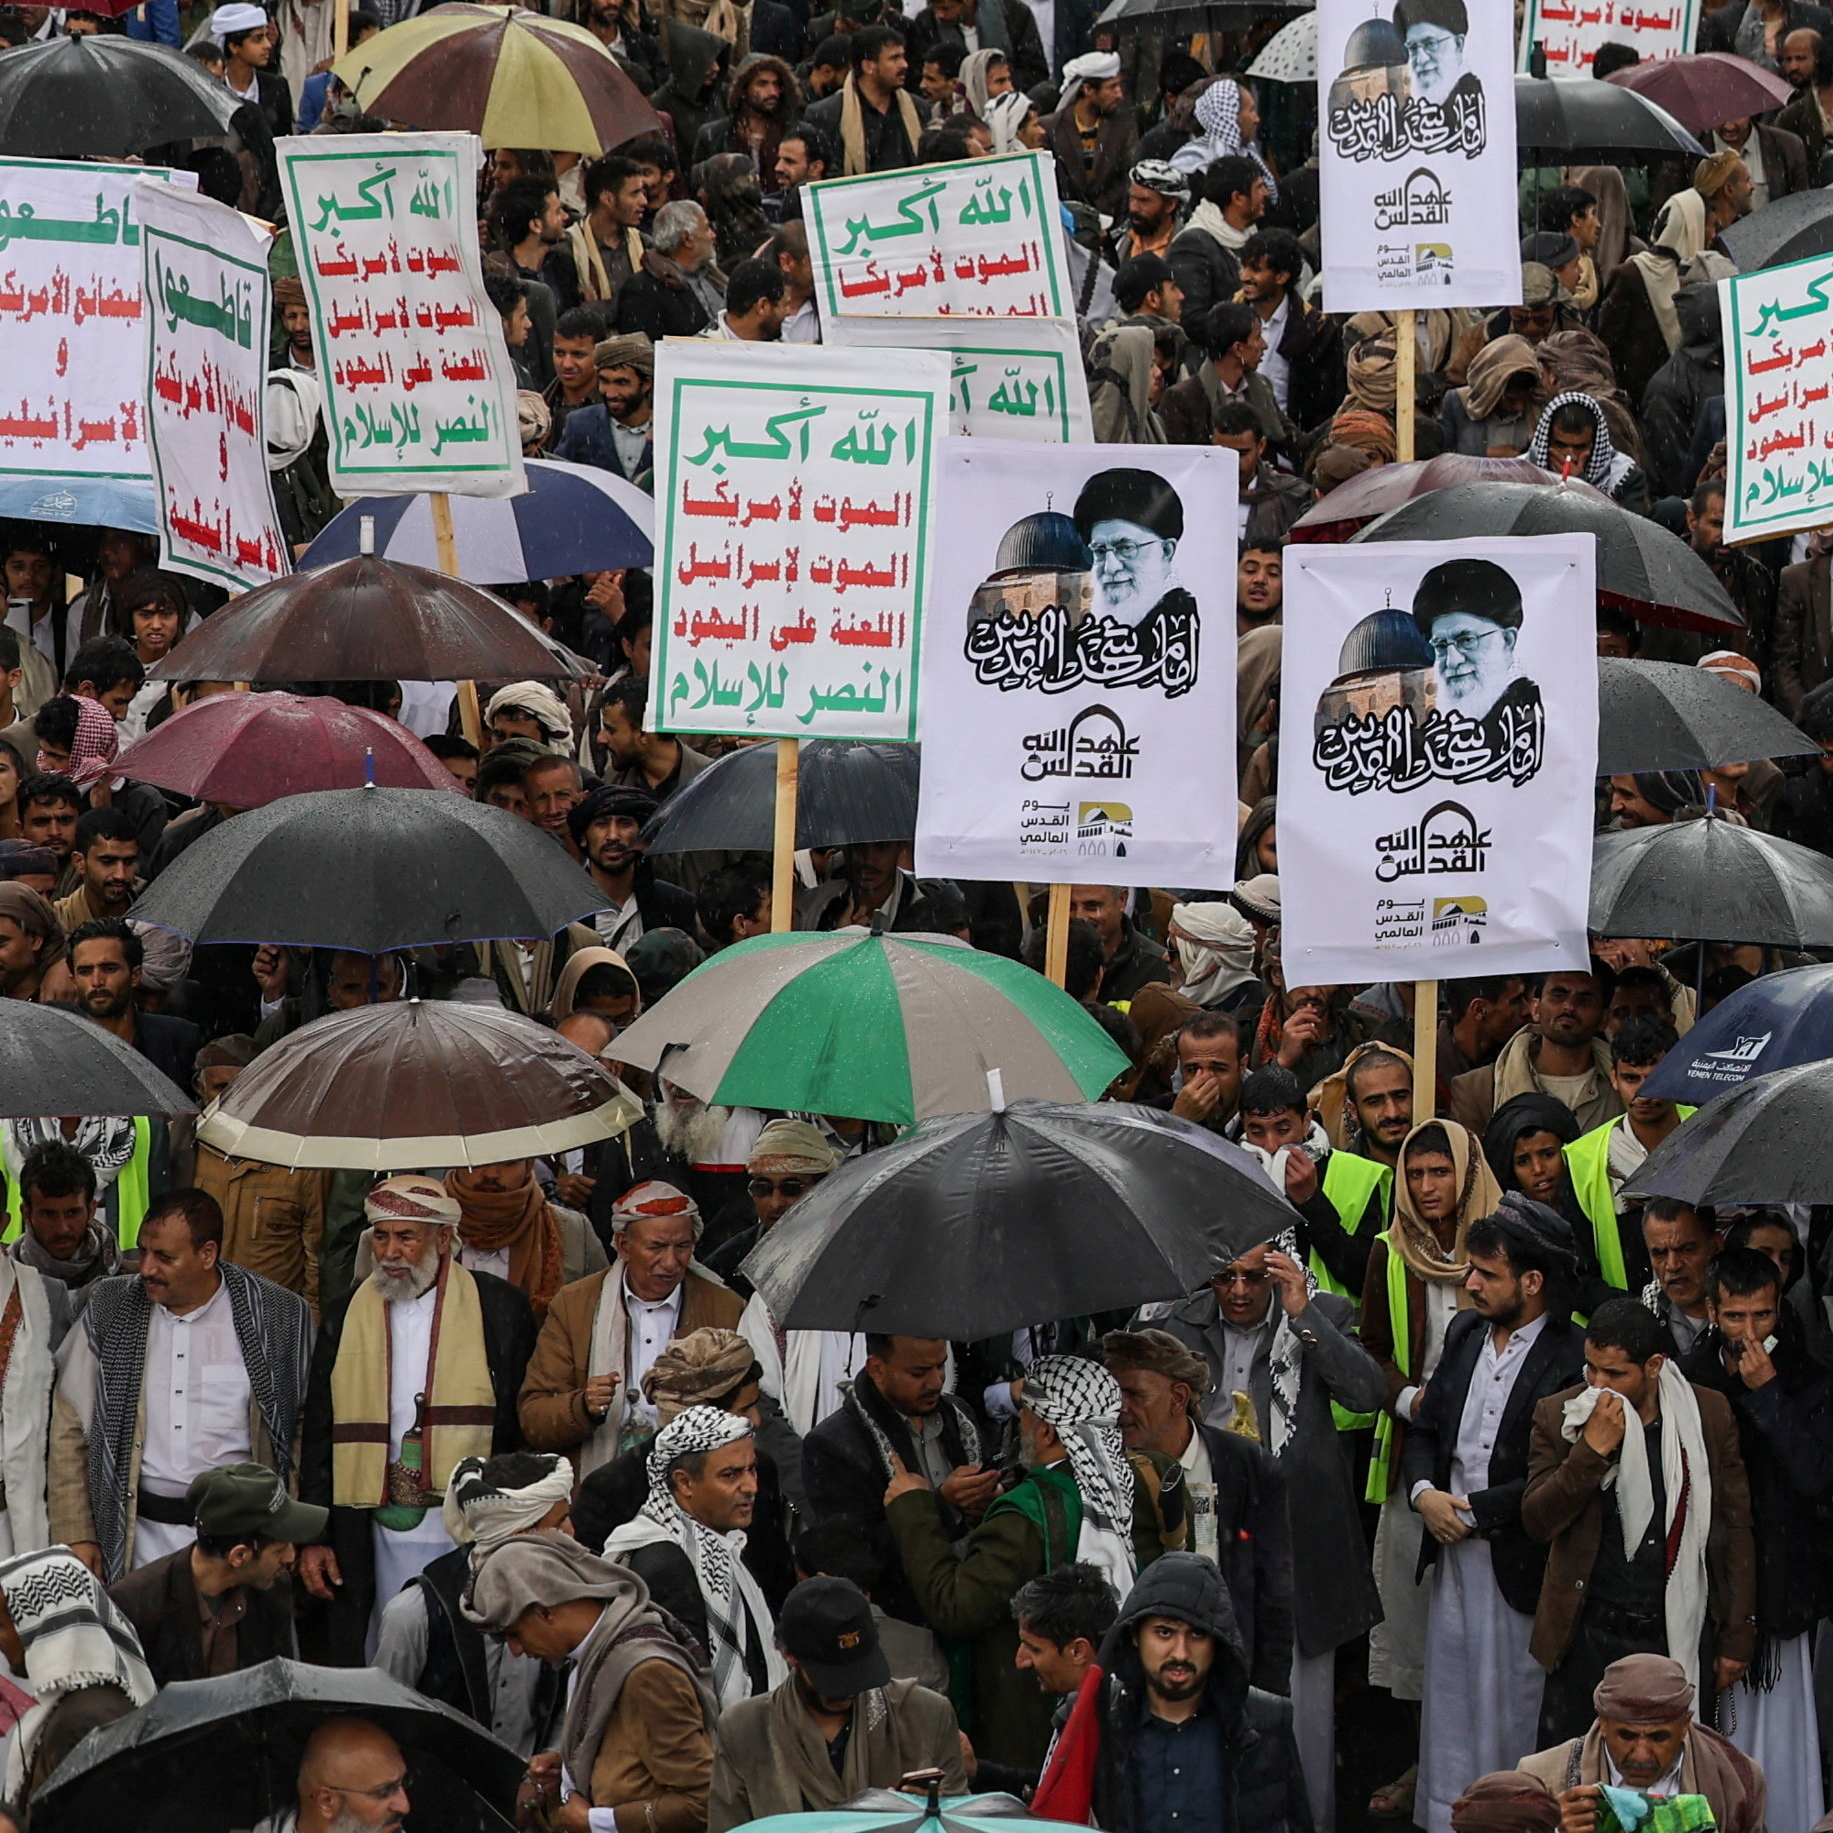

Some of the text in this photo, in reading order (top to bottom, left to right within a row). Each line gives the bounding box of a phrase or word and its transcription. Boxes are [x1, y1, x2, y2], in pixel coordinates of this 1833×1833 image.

[1377, 244, 1410, 253] يوم
[1377, 257, 1410, 267] القدس
[1377, 269, 1411, 281] العالمي
[683, 398, 916, 474] الله أكبر
[1746, 421, 1814, 462] اليهود
[682, 480, 912, 533] الموت لأمريكا
[677, 543, 908, 594] الموت لإسرائيل
[673, 606, 905, 651] اللعنة على اليهود
[671, 660, 902, 724] النصر للإسلام
[1022, 799, 1071, 811] يوم
[1021, 815, 1069, 828] القدس
[1020, 832, 1068, 845] العالمي
[1687, 1069, 1745, 1081] YEMEN TELECOM
